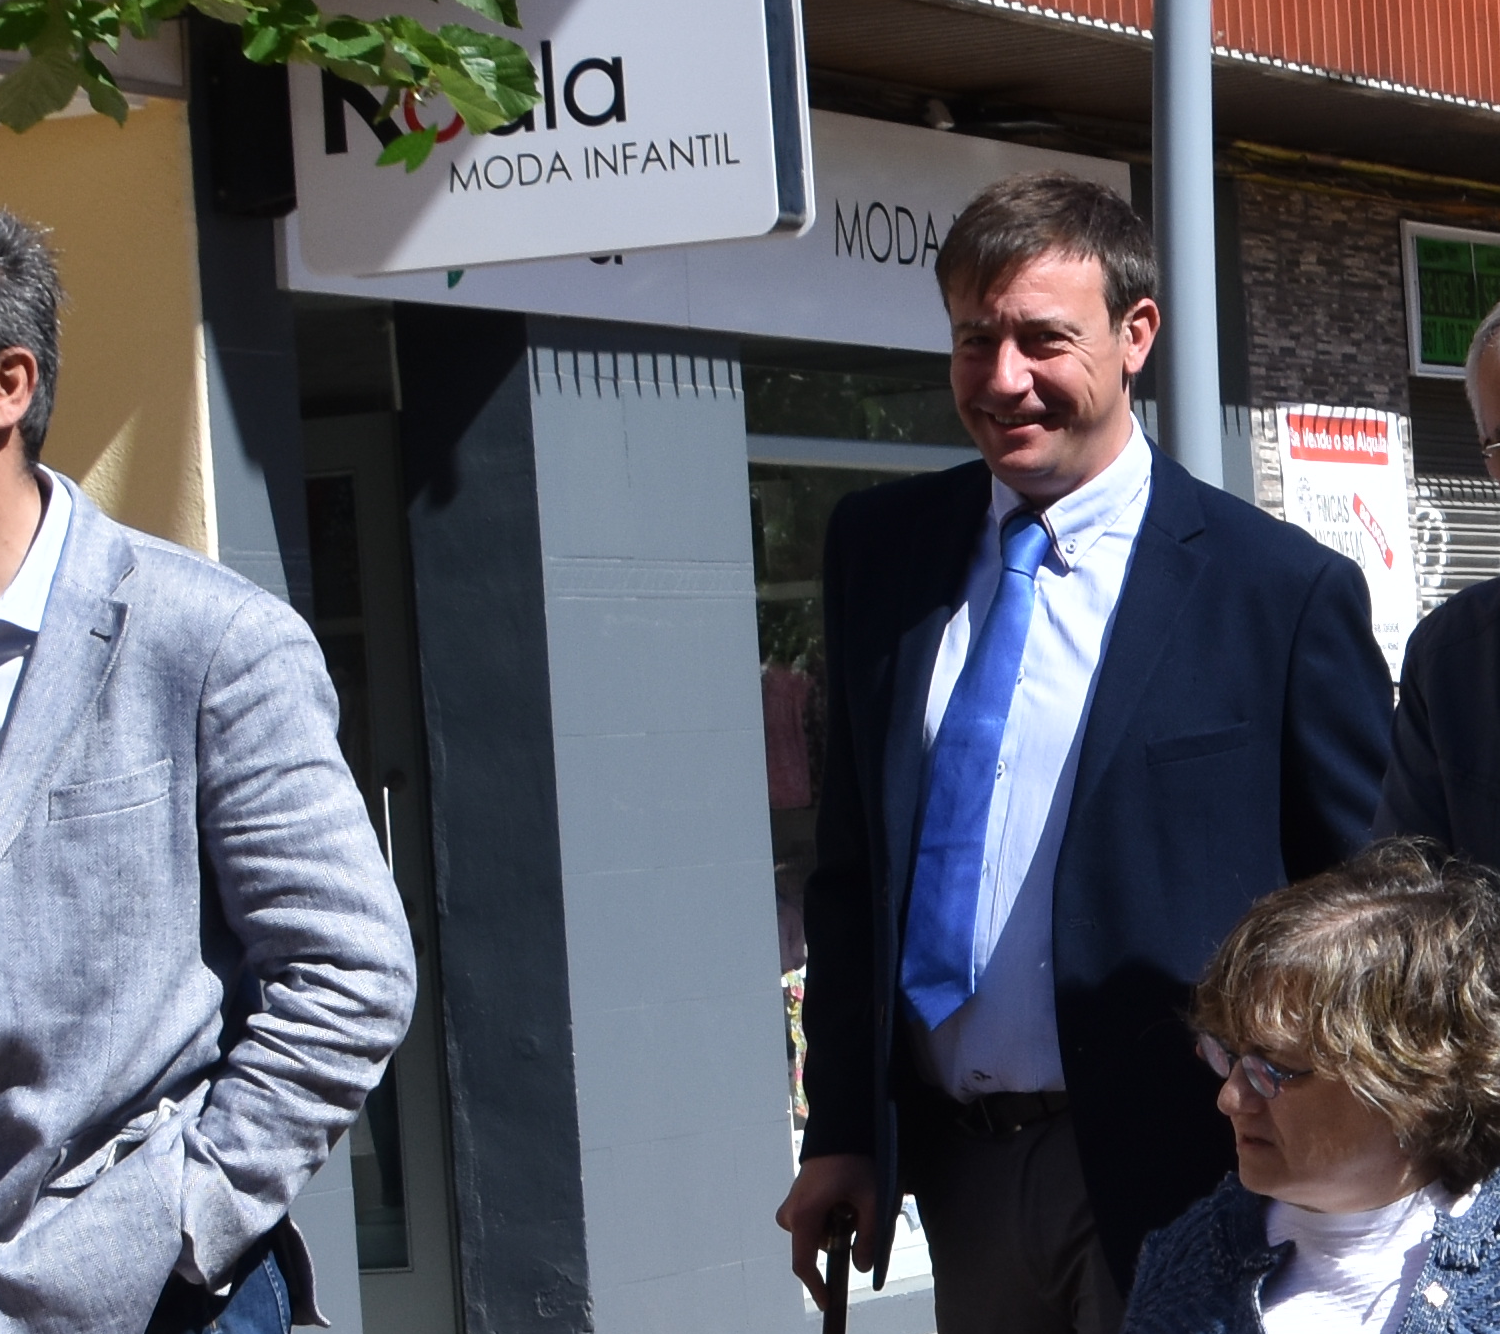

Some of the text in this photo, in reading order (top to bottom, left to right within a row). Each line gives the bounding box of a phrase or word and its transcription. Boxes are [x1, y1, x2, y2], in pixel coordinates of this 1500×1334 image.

[449, 132, 740, 193] MODA INFANTIL
[835, 197, 940, 268] MODA
[1316, 493, 1350, 524] FINCAS
